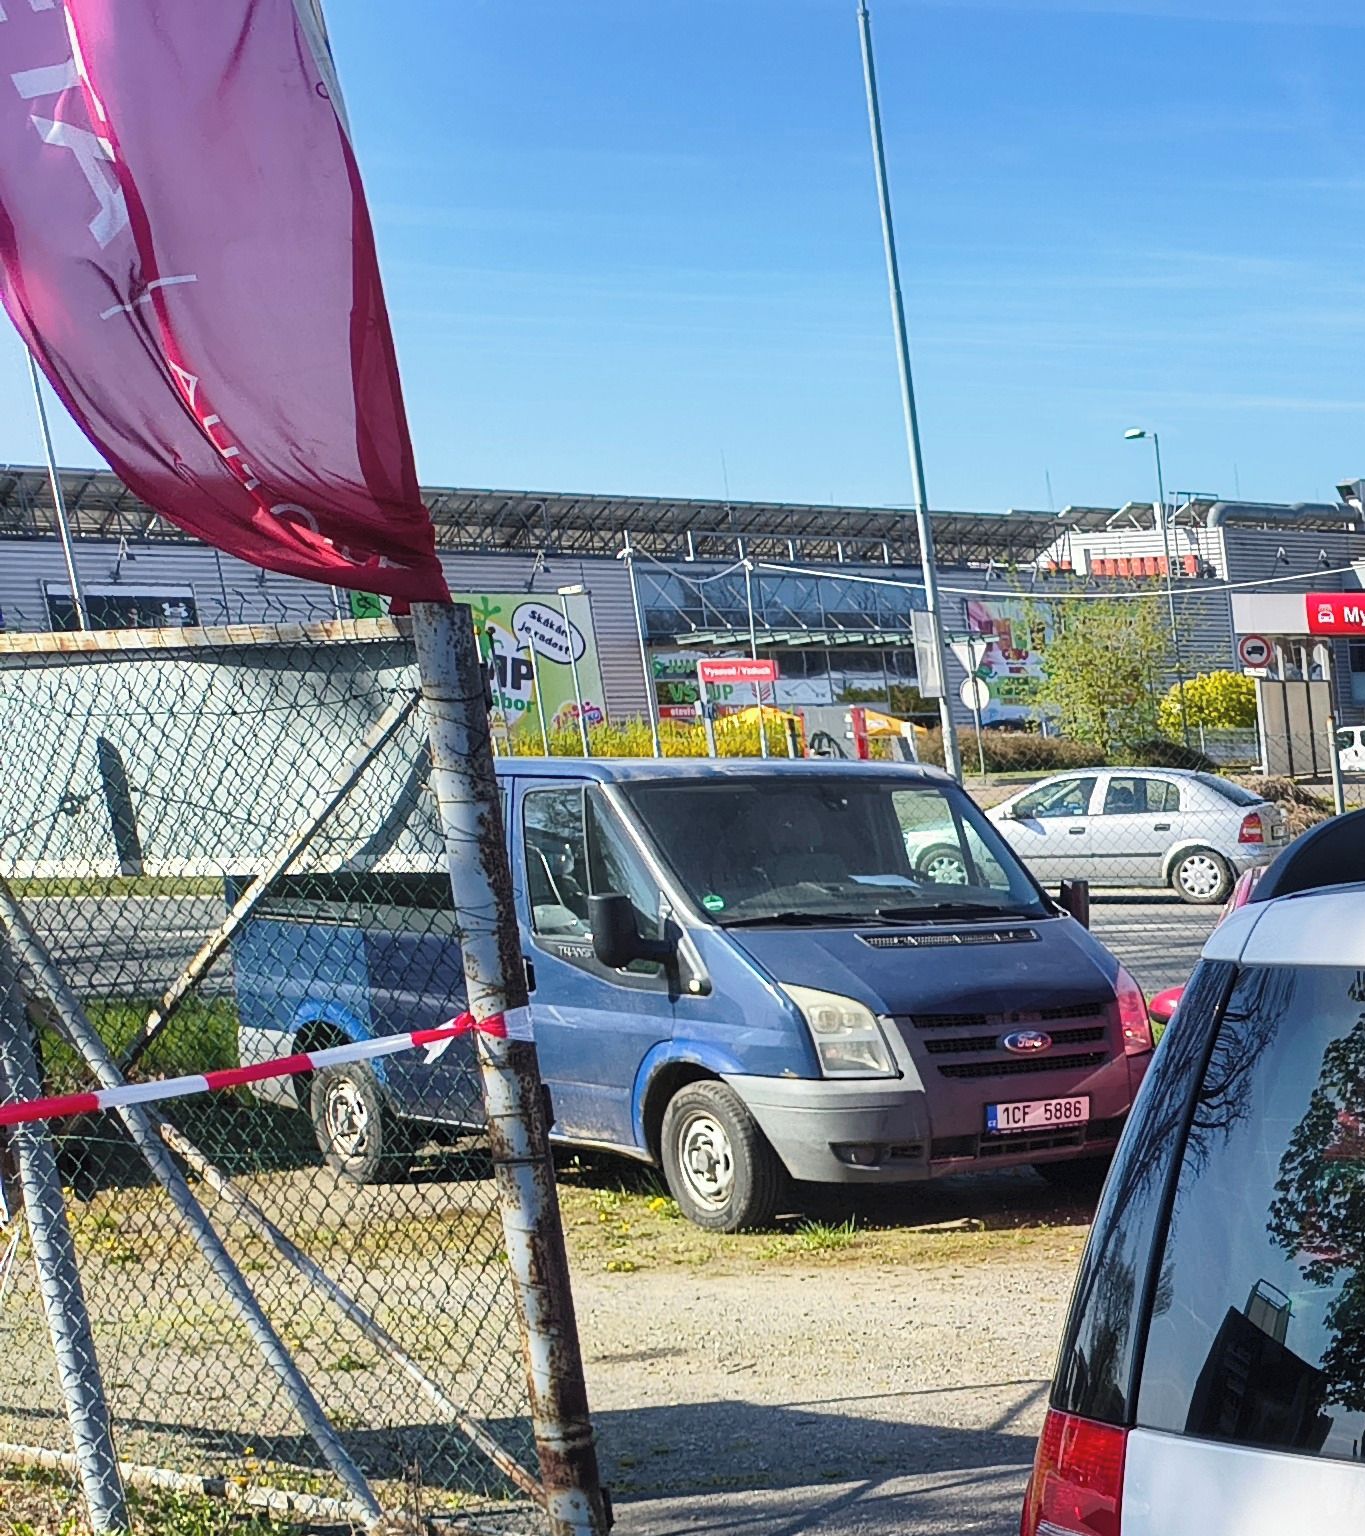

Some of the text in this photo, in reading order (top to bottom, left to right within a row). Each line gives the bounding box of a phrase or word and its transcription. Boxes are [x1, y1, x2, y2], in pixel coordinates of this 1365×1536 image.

[668, 683, 734, 703] VSUP
[1003, 1104, 1031, 1125] 1CF
[1044, 1101, 1082, 1121] 5886
